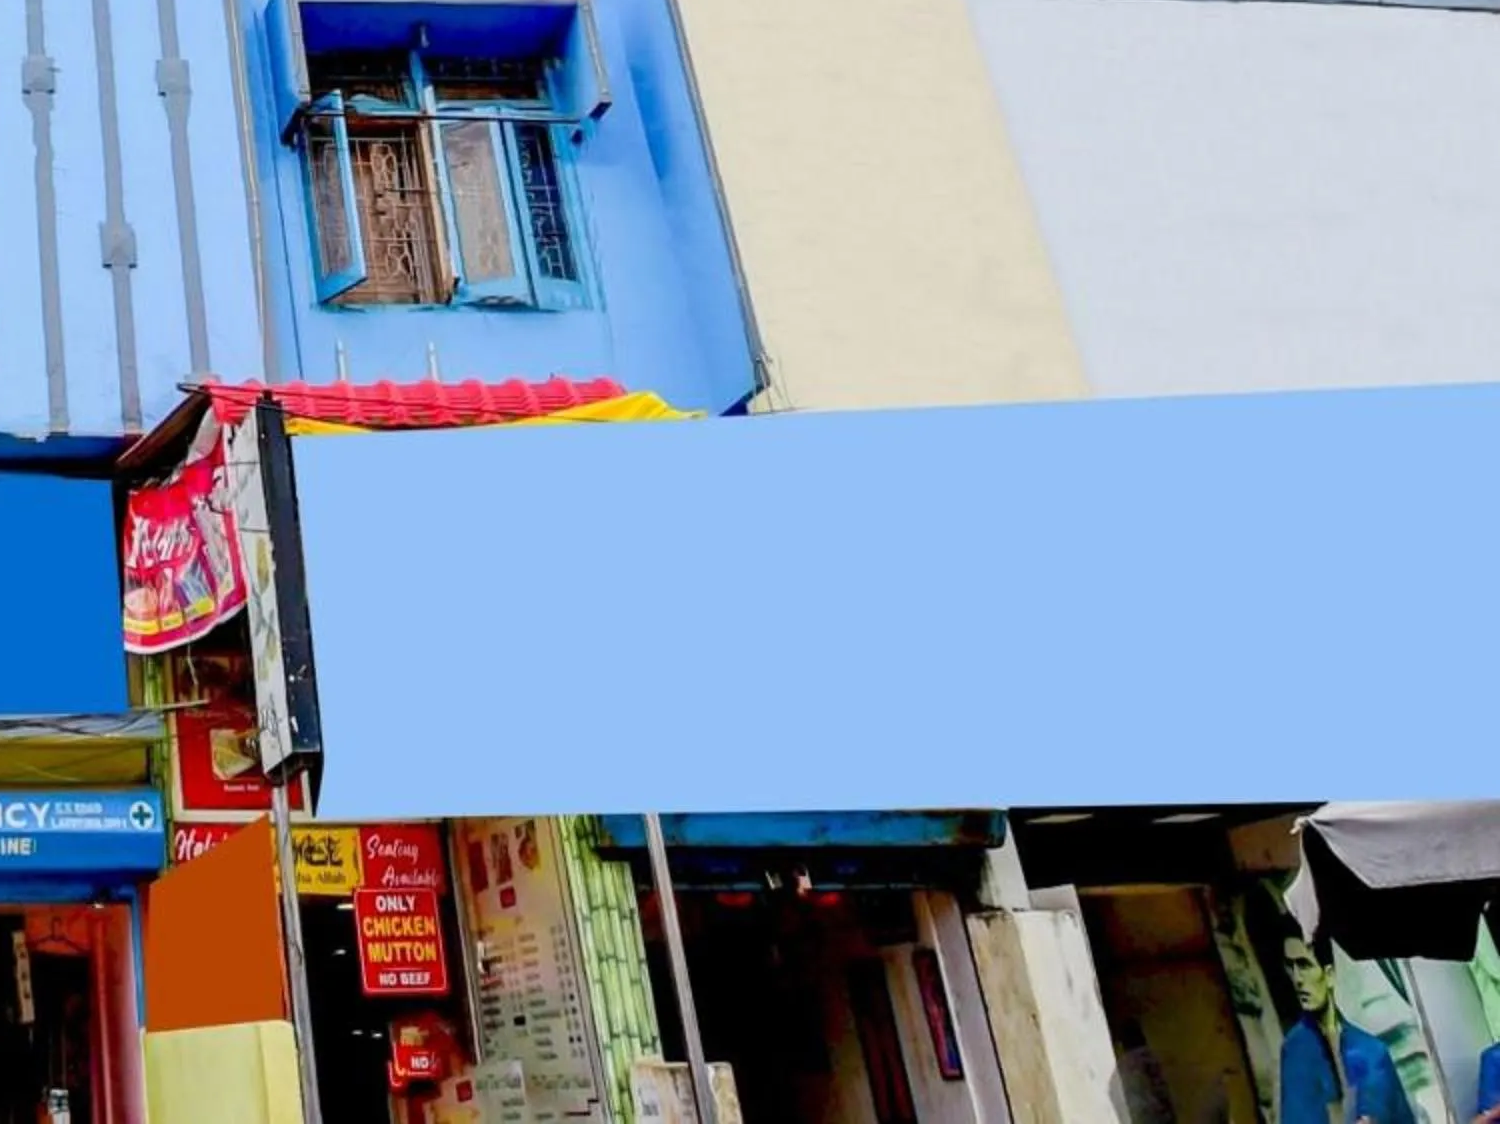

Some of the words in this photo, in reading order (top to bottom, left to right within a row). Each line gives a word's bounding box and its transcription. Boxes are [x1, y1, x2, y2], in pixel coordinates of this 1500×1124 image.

[375, 895, 415, 912] ONLY
[363, 916, 436, 937] CHICKEN
[368, 942, 437, 963] MUTTON
[379, 973, 397, 985] NO
